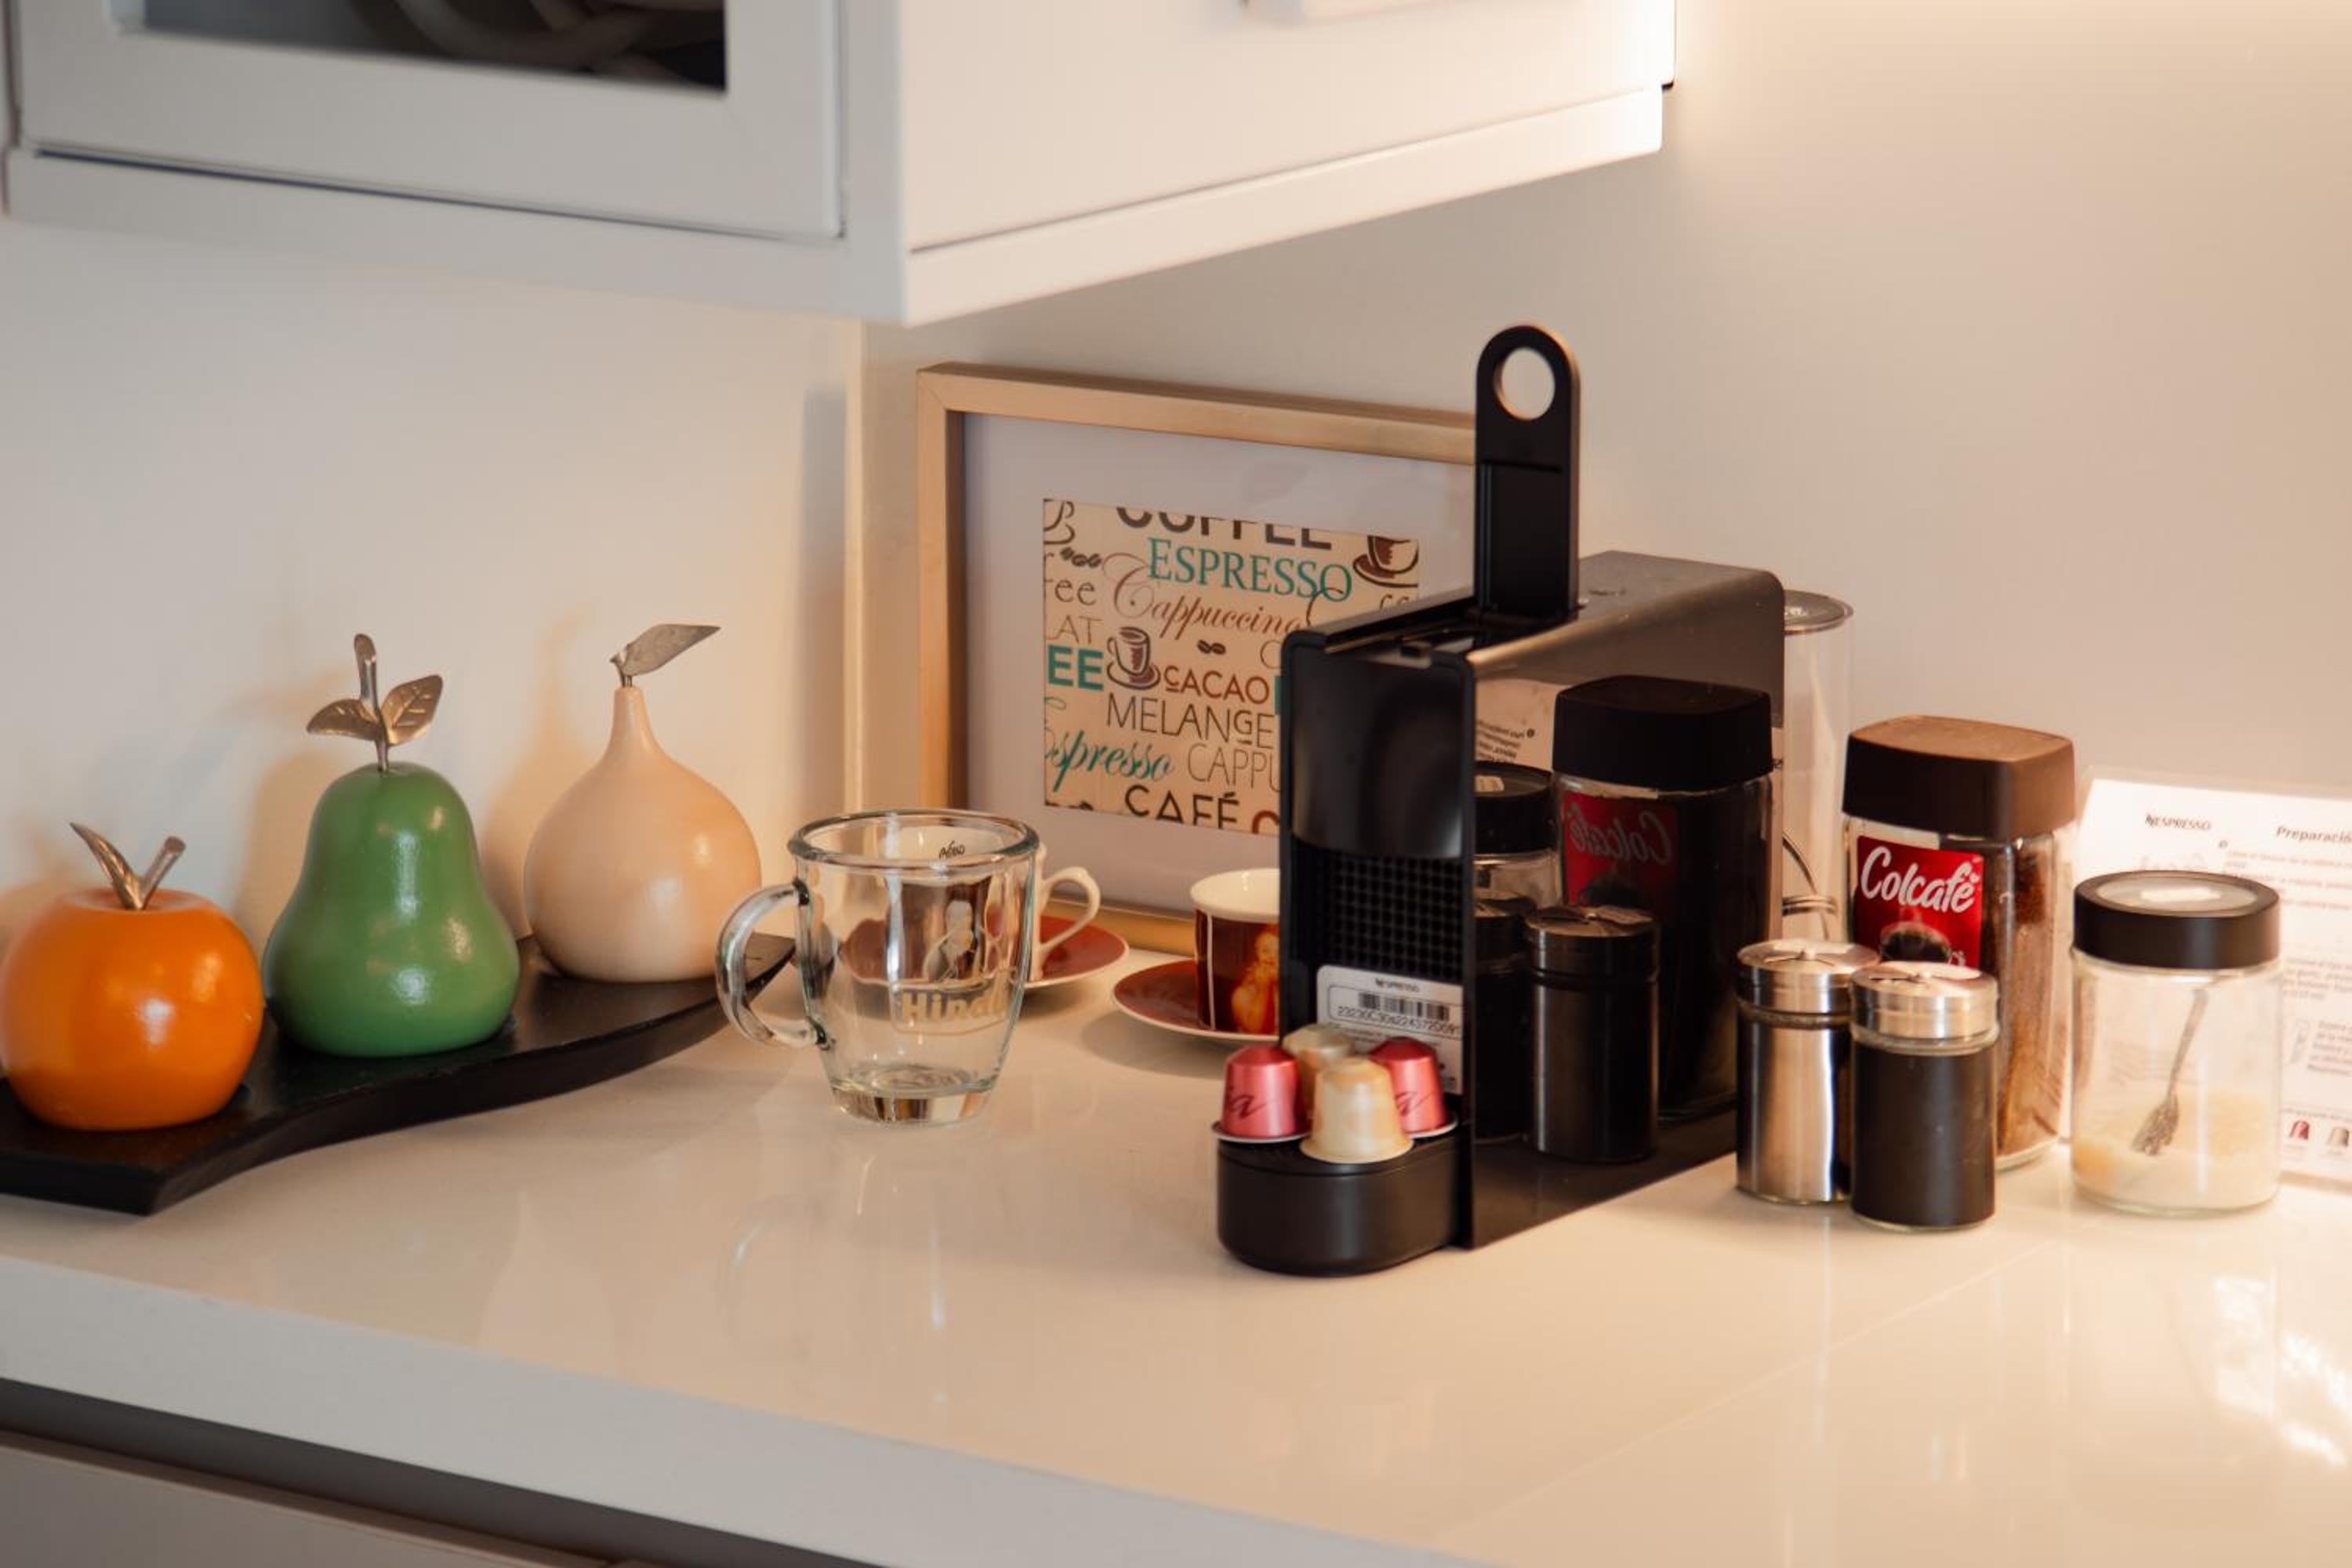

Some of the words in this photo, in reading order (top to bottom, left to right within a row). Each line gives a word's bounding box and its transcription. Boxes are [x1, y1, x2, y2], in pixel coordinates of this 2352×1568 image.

[1147, 537, 1352, 602] ESPRESSO
[1048, 644, 1104, 691] EE
[1163, 665, 1269, 704] CACAO
[1107, 693, 1275, 750] MELANGE
[1860, 846, 1980, 913] Colcafé
